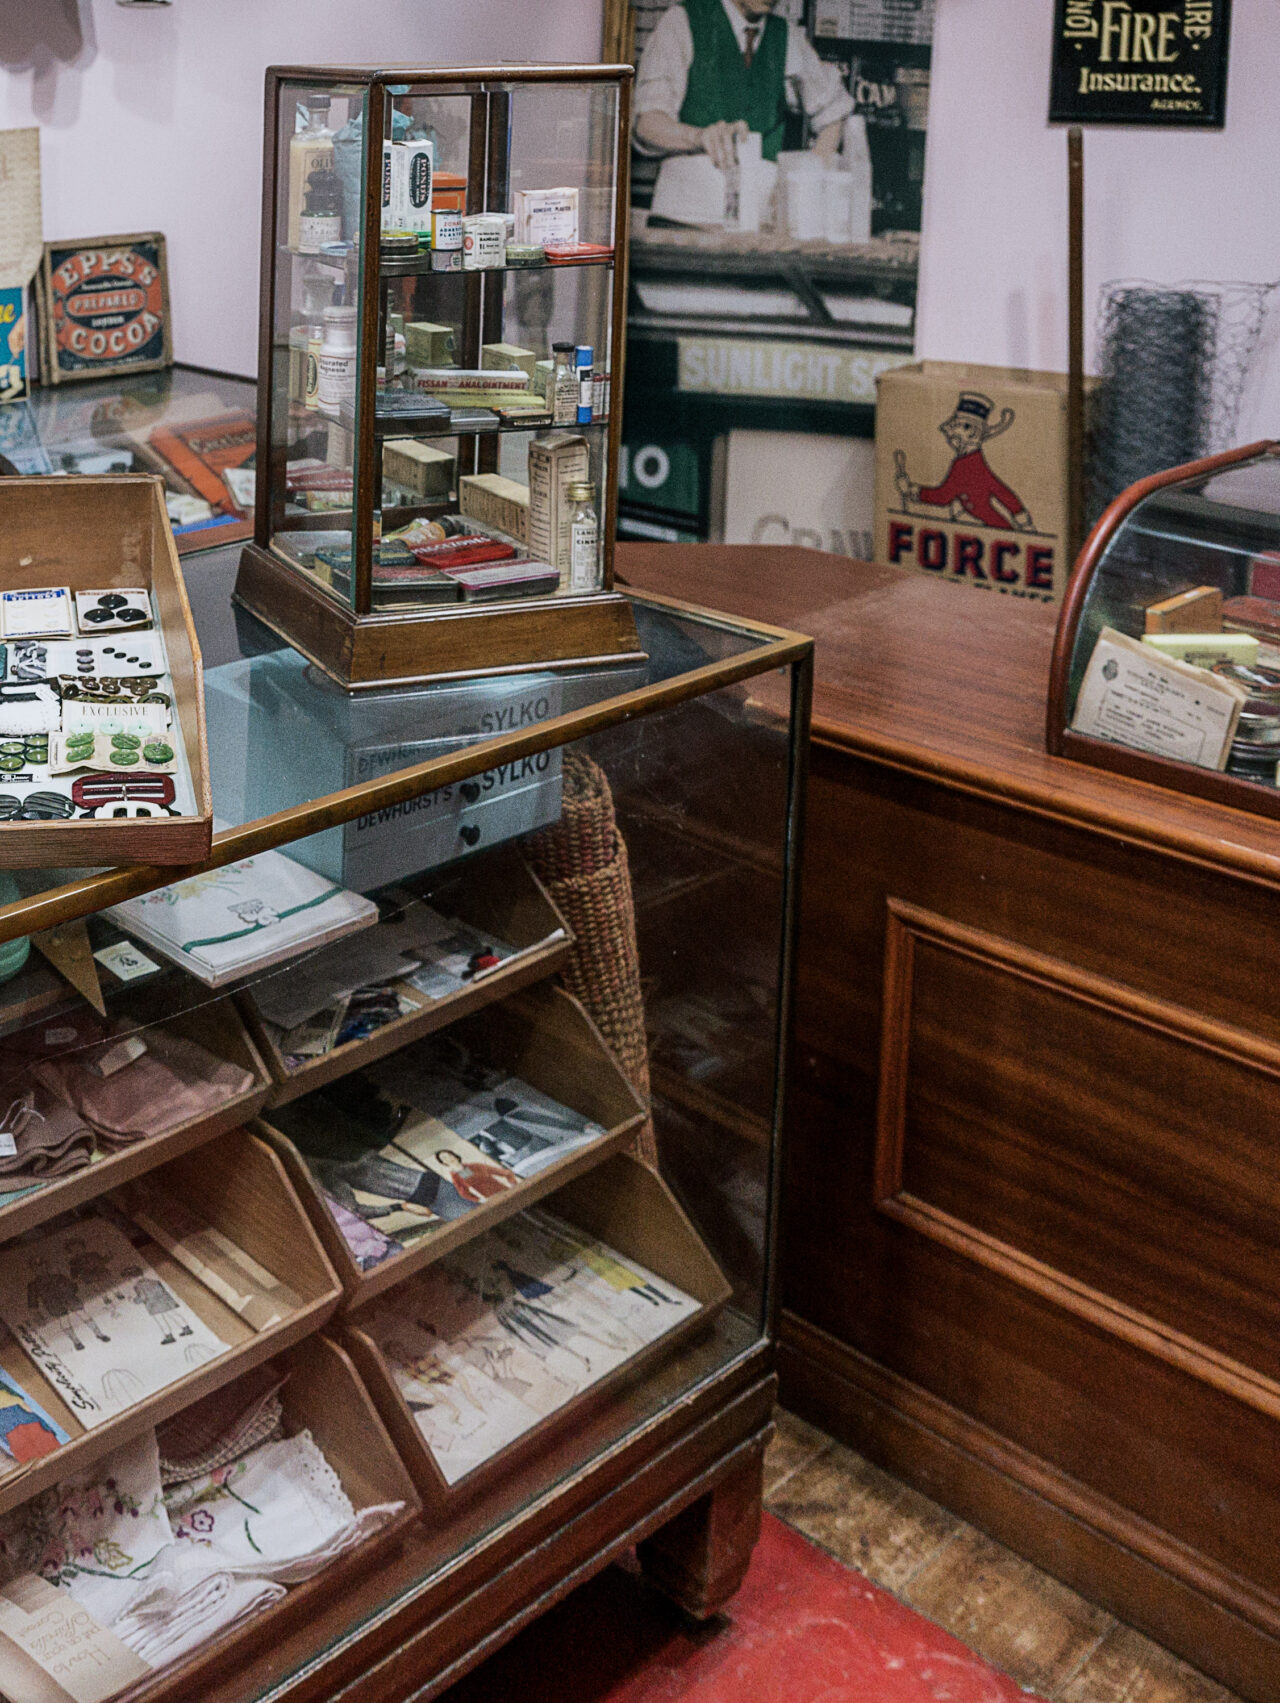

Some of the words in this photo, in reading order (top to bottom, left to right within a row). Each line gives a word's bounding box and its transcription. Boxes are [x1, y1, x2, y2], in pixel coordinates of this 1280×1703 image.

[1063, 0, 1099, 39] LON
[1098, 1, 1181, 63] FIRE
[1183, 0, 1213, 40] IRE
[1078, 66, 1203, 95] Insurance.
[70, 311, 160, 356] COCOA
[681, 344, 843, 395] SUNLIGHT
[888, 519, 1054, 590] FORCE
[81, 705, 150, 717] EXCLUSIVE
[481, 696, 551, 734] SYLKO
[356, 785, 454, 832] DEWHURST'S
[482, 751, 552, 792] SYLKO
